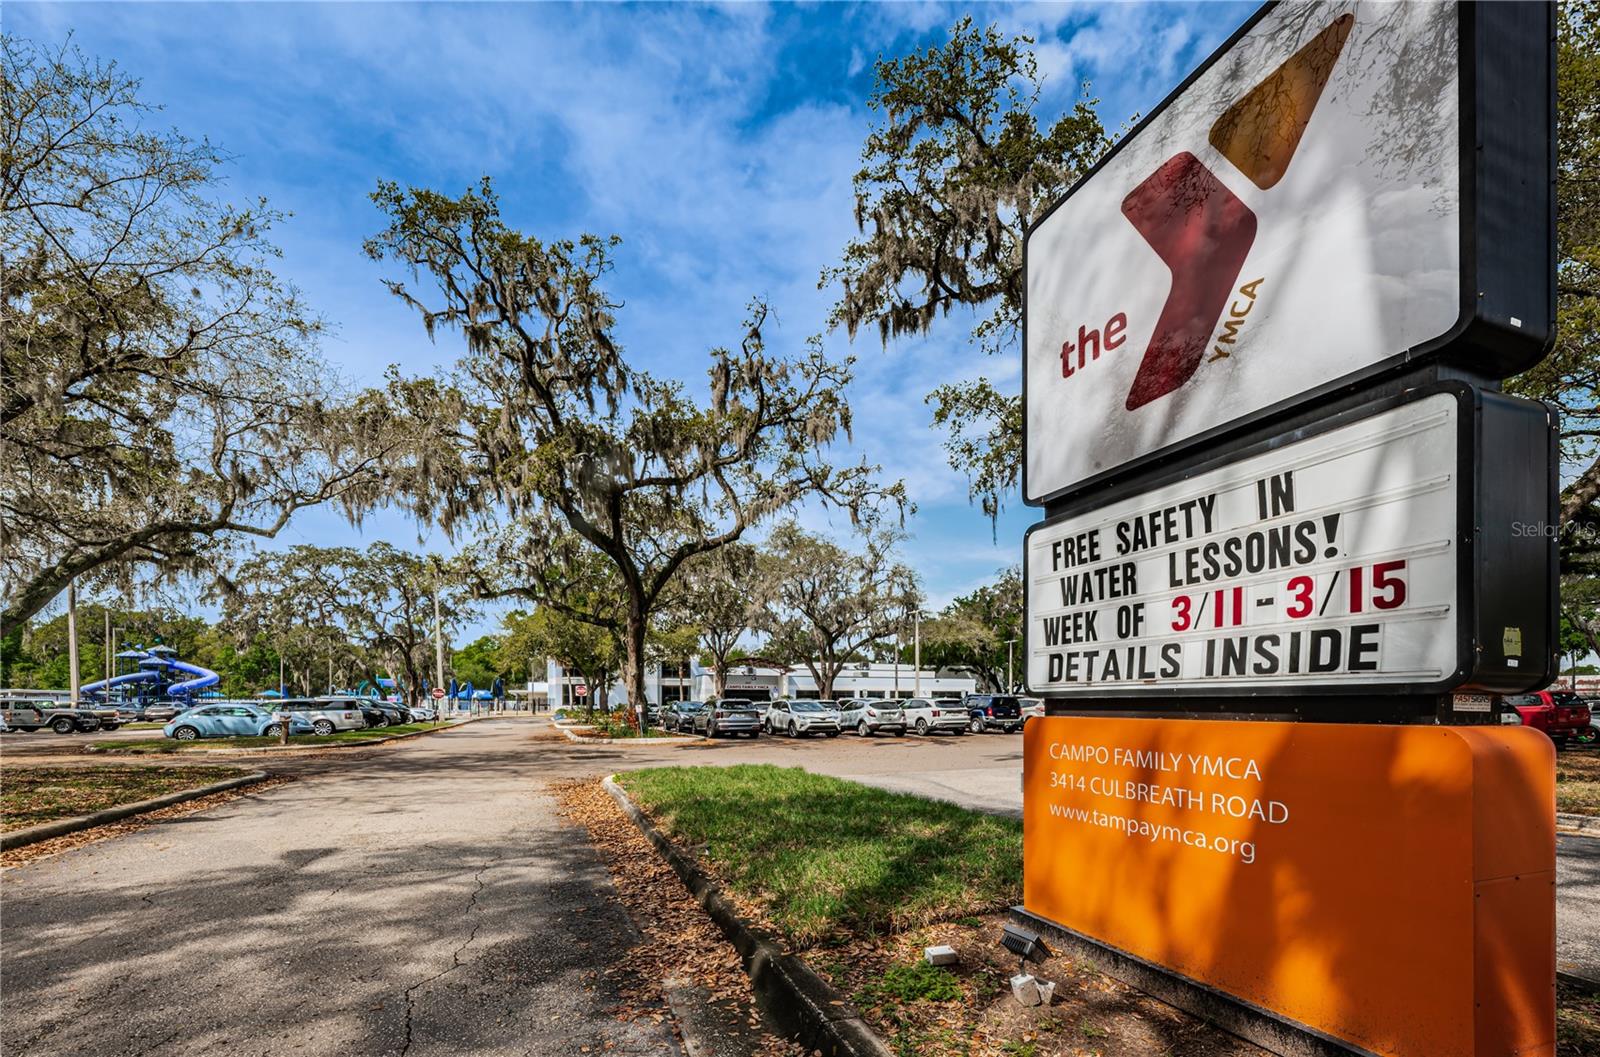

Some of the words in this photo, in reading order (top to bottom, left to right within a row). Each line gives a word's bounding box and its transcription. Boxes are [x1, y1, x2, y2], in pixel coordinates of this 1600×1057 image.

[1060, 312, 1127, 379] the
[1207, 277, 1264, 364] YMCA
[1052, 529, 1101, 572] FREE
[1116, 493, 1216, 556] SAFETY
[1257, 470, 1295, 521] IN
[1060, 561, 1138, 607] WATER
[1168, 512, 1341, 588] LESSONS!
[1043, 610, 1099, 646] WEEK
[1117, 602, 1145, 639] OF
[1048, 642, 1182, 683] DETAILS
[1205, 623, 1380, 677] INSIDE
[1049, 742, 1110, 765] CAMPO
[1113, 747, 1183, 772] FAMILY
[1187, 754, 1262, 782] YMCA
[1049, 771, 1086, 792] 3414
[1089, 776, 1204, 812] CULBREATH
[1211, 793, 1289, 824] ROAD
[1049, 802, 1256, 864] www.tampaymca.org
